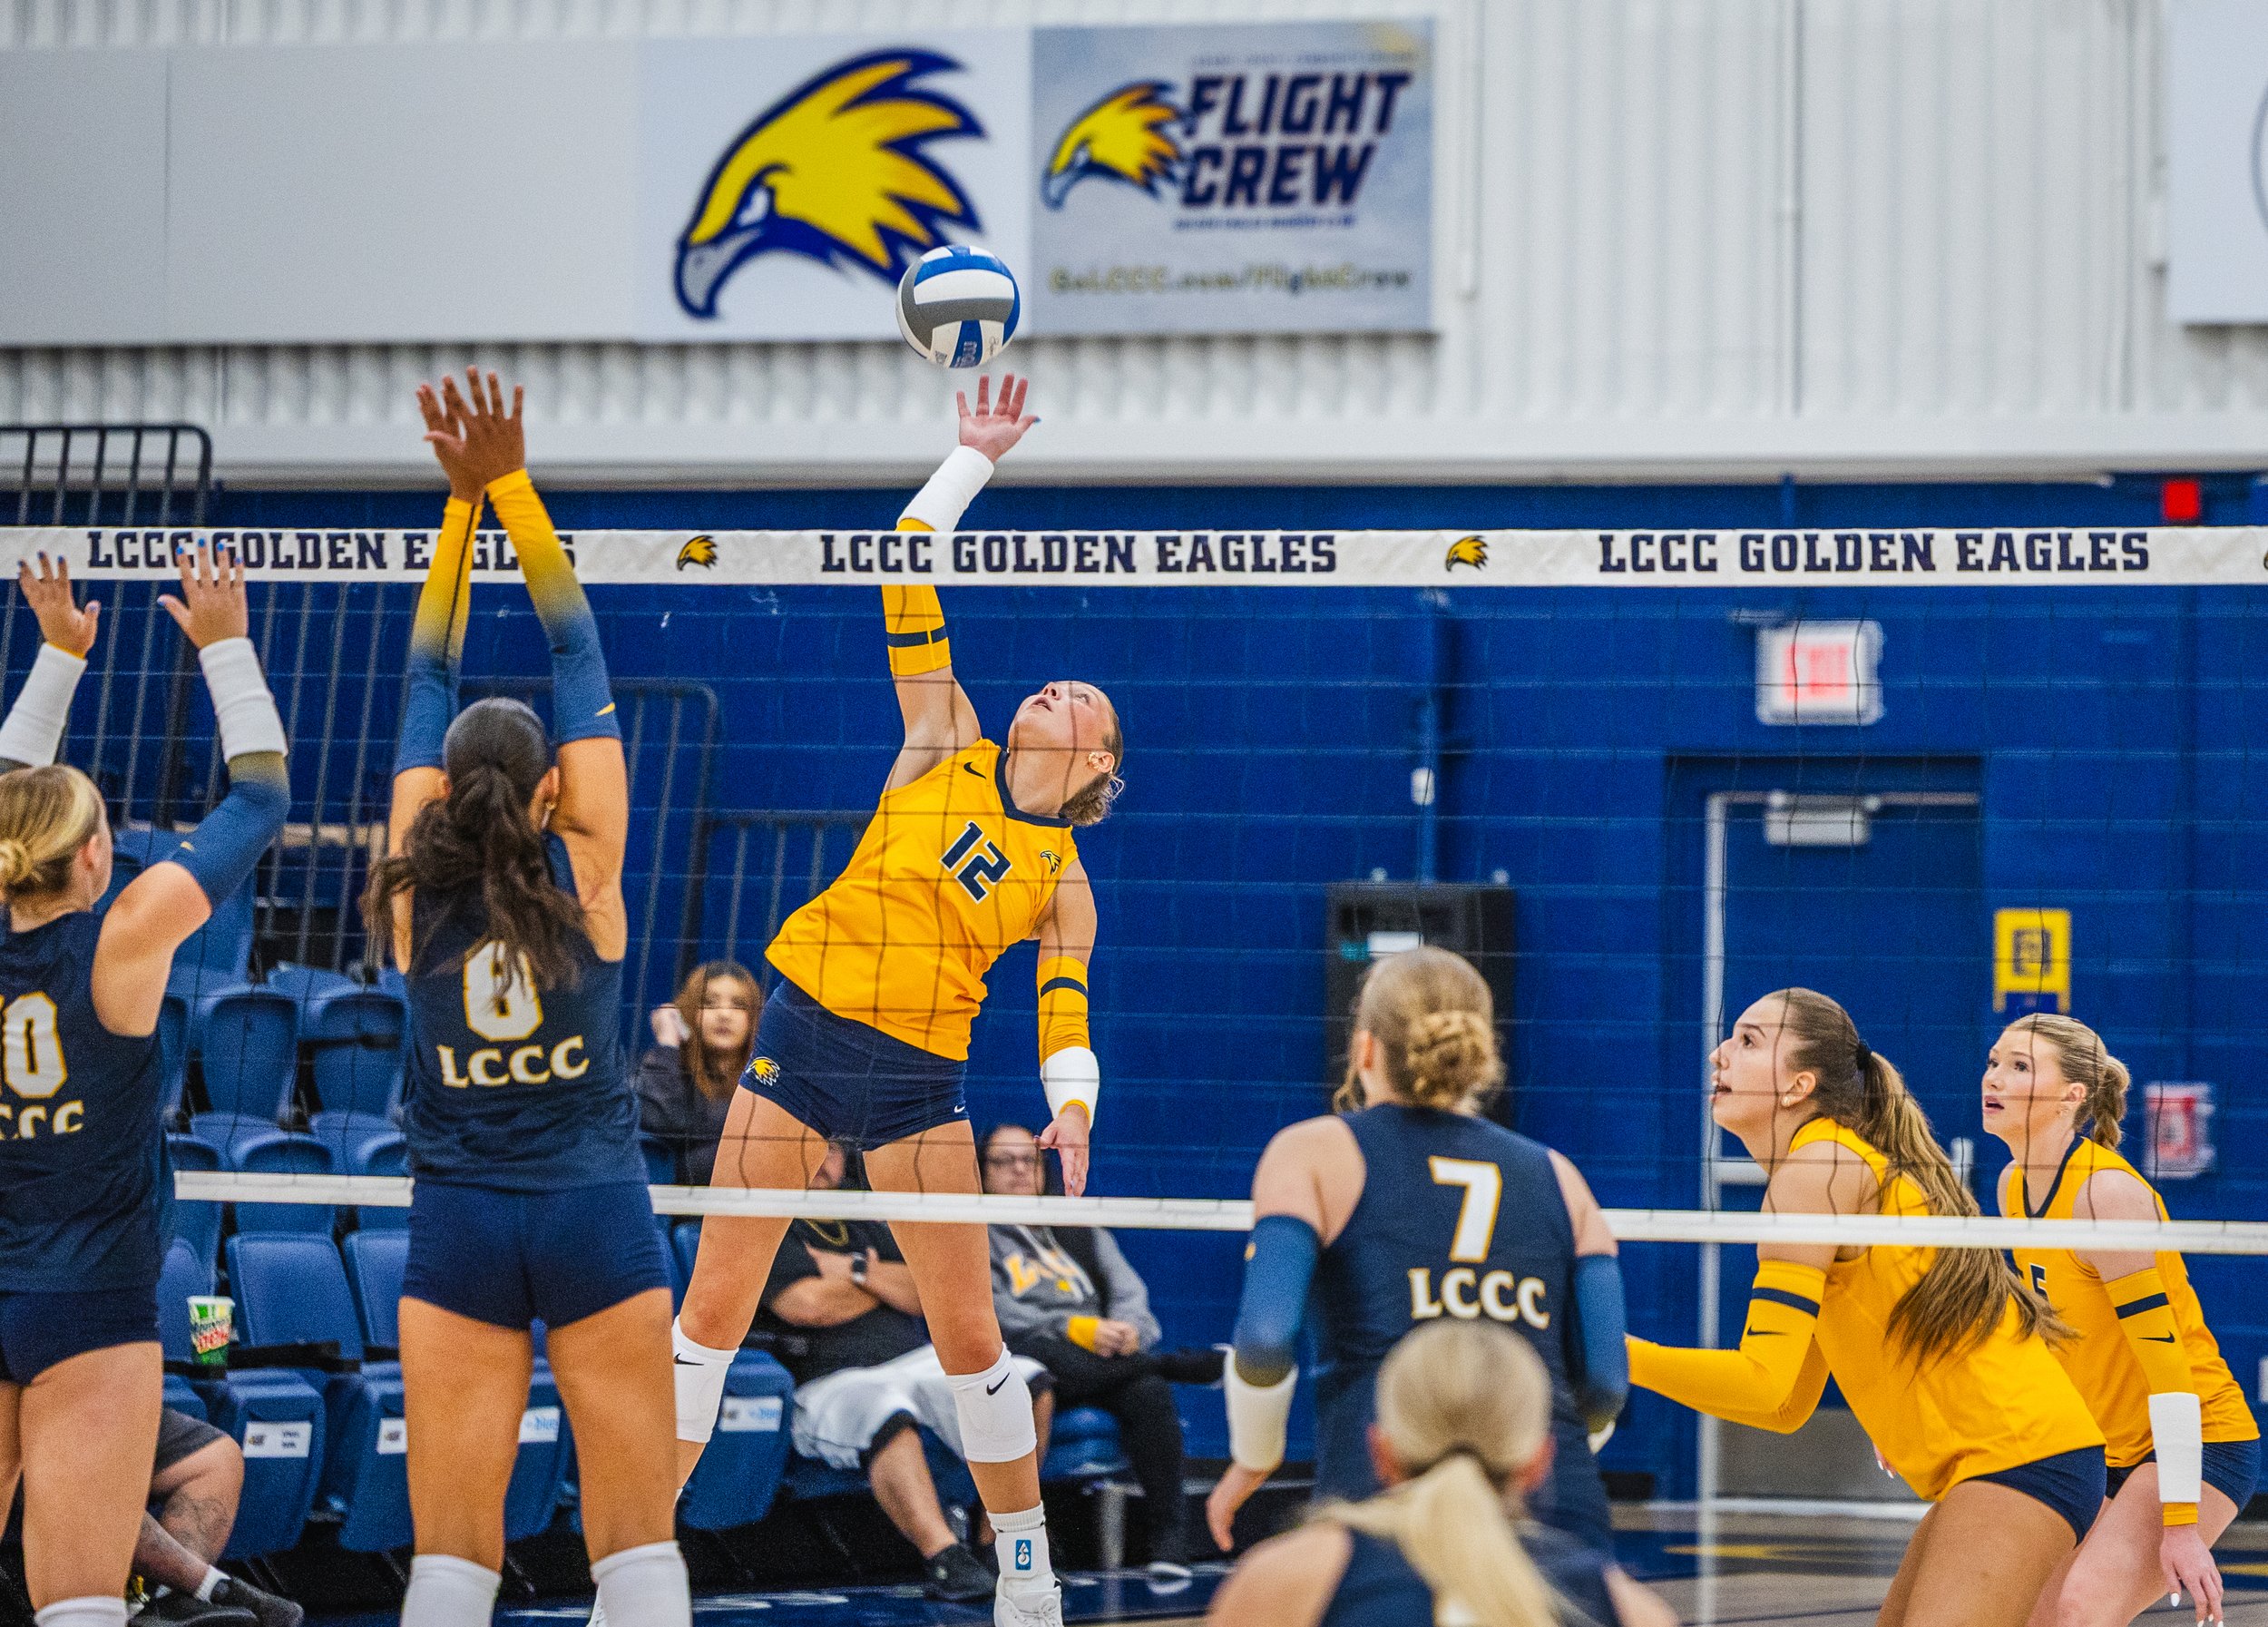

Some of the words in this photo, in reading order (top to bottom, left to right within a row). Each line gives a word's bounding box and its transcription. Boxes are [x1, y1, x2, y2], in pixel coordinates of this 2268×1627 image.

[1183, 72, 1412, 136] FLIGHT
[1182, 143, 1376, 208] CREW
[88, 531, 194, 568] LCCC
[212, 532, 386, 569] GOLDEN
[404, 534, 575, 570] EGLS
[821, 534, 933, 573] LCCC
[953, 535, 1137, 573] GOLDEN
[1156, 535, 1336, 572] EAGLES
[1599, 534, 1717, 572] LCCC
[1740, 534, 1936, 572] GOLDEN
[1956, 534, 2149, 571] EAGLES
[939, 820, 1012, 905] 12
[0, 990, 68, 1099] 0
[436, 1035, 590, 1088] LCCC
[1427, 1155, 1503, 1264] 7
[1408, 1267, 1550, 1329] LCCC
